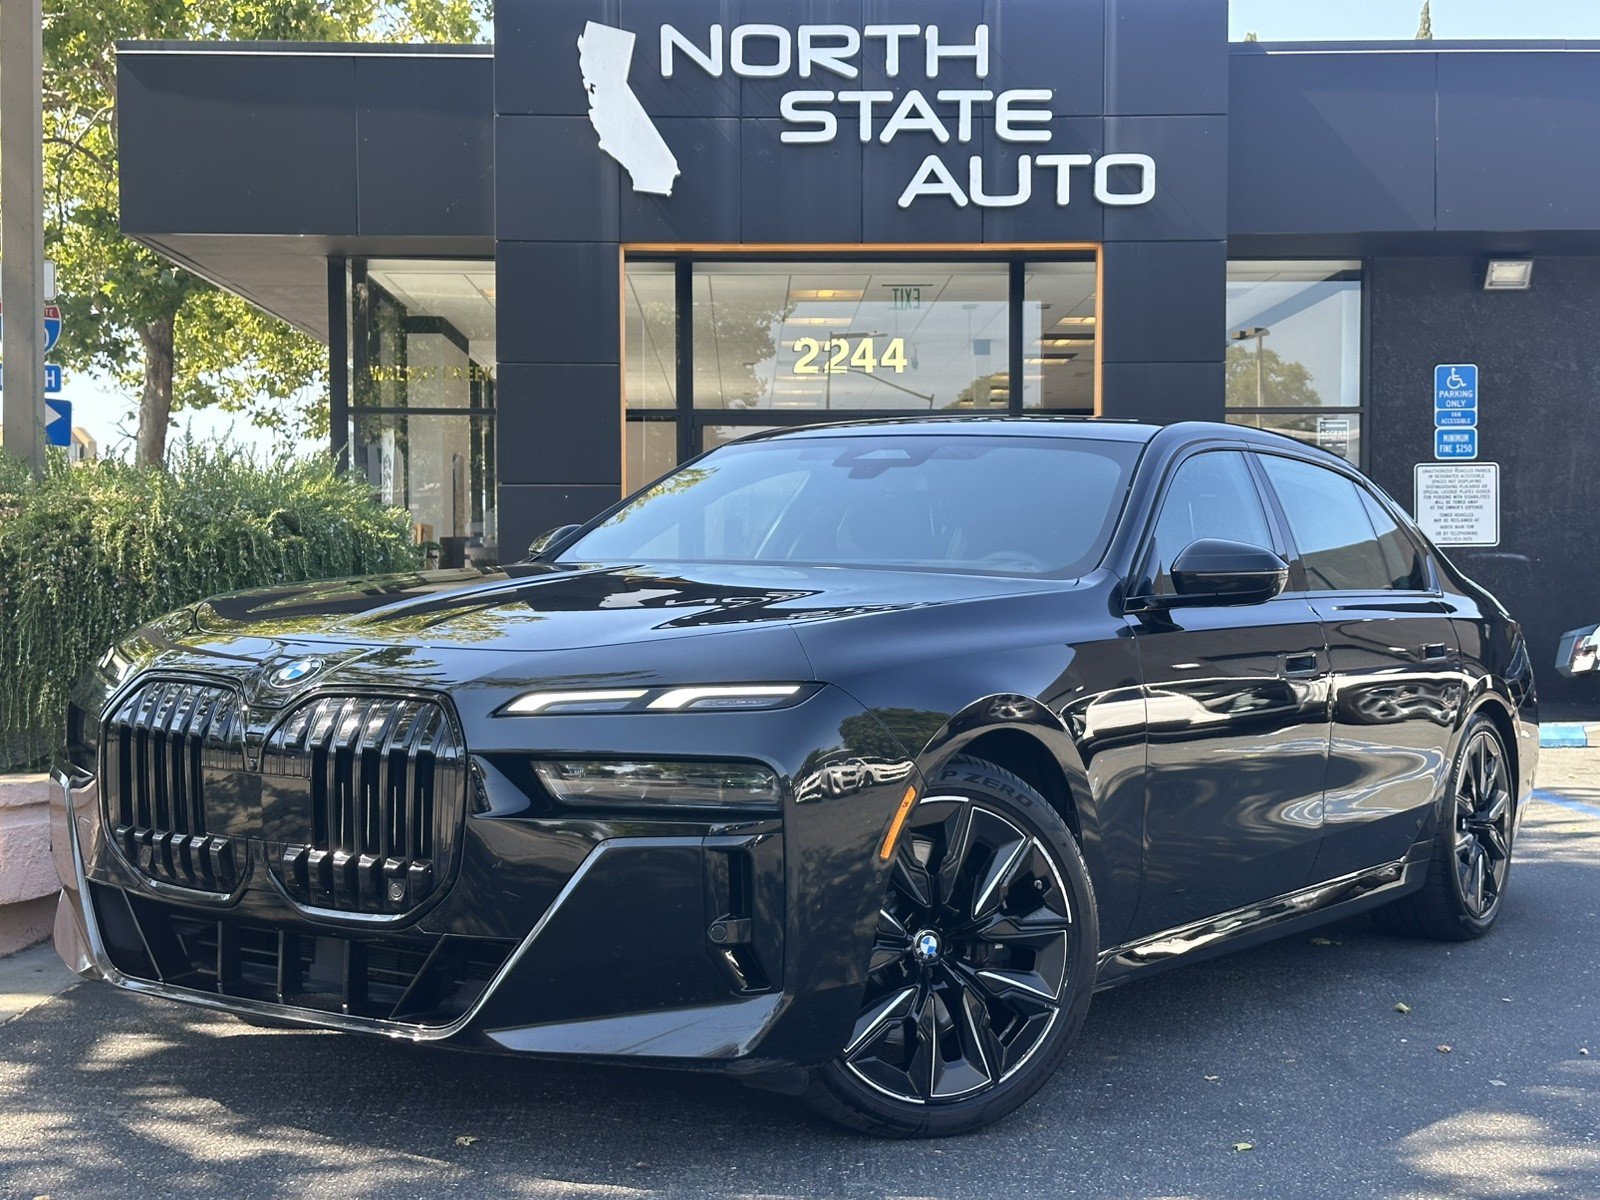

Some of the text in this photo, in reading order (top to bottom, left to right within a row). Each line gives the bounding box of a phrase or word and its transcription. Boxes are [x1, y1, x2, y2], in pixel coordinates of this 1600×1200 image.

[660, 23, 989, 79] NORTH
[780, 89, 1053, 144] STATE
[897, 153, 1156, 208] AUTO
[793, 338, 907, 374] 2244
[1439, 390, 1473, 398] PARKING
[1440, 444, 1472, 453] FINE $250
[940, 771, 1034, 808] P ZERO
